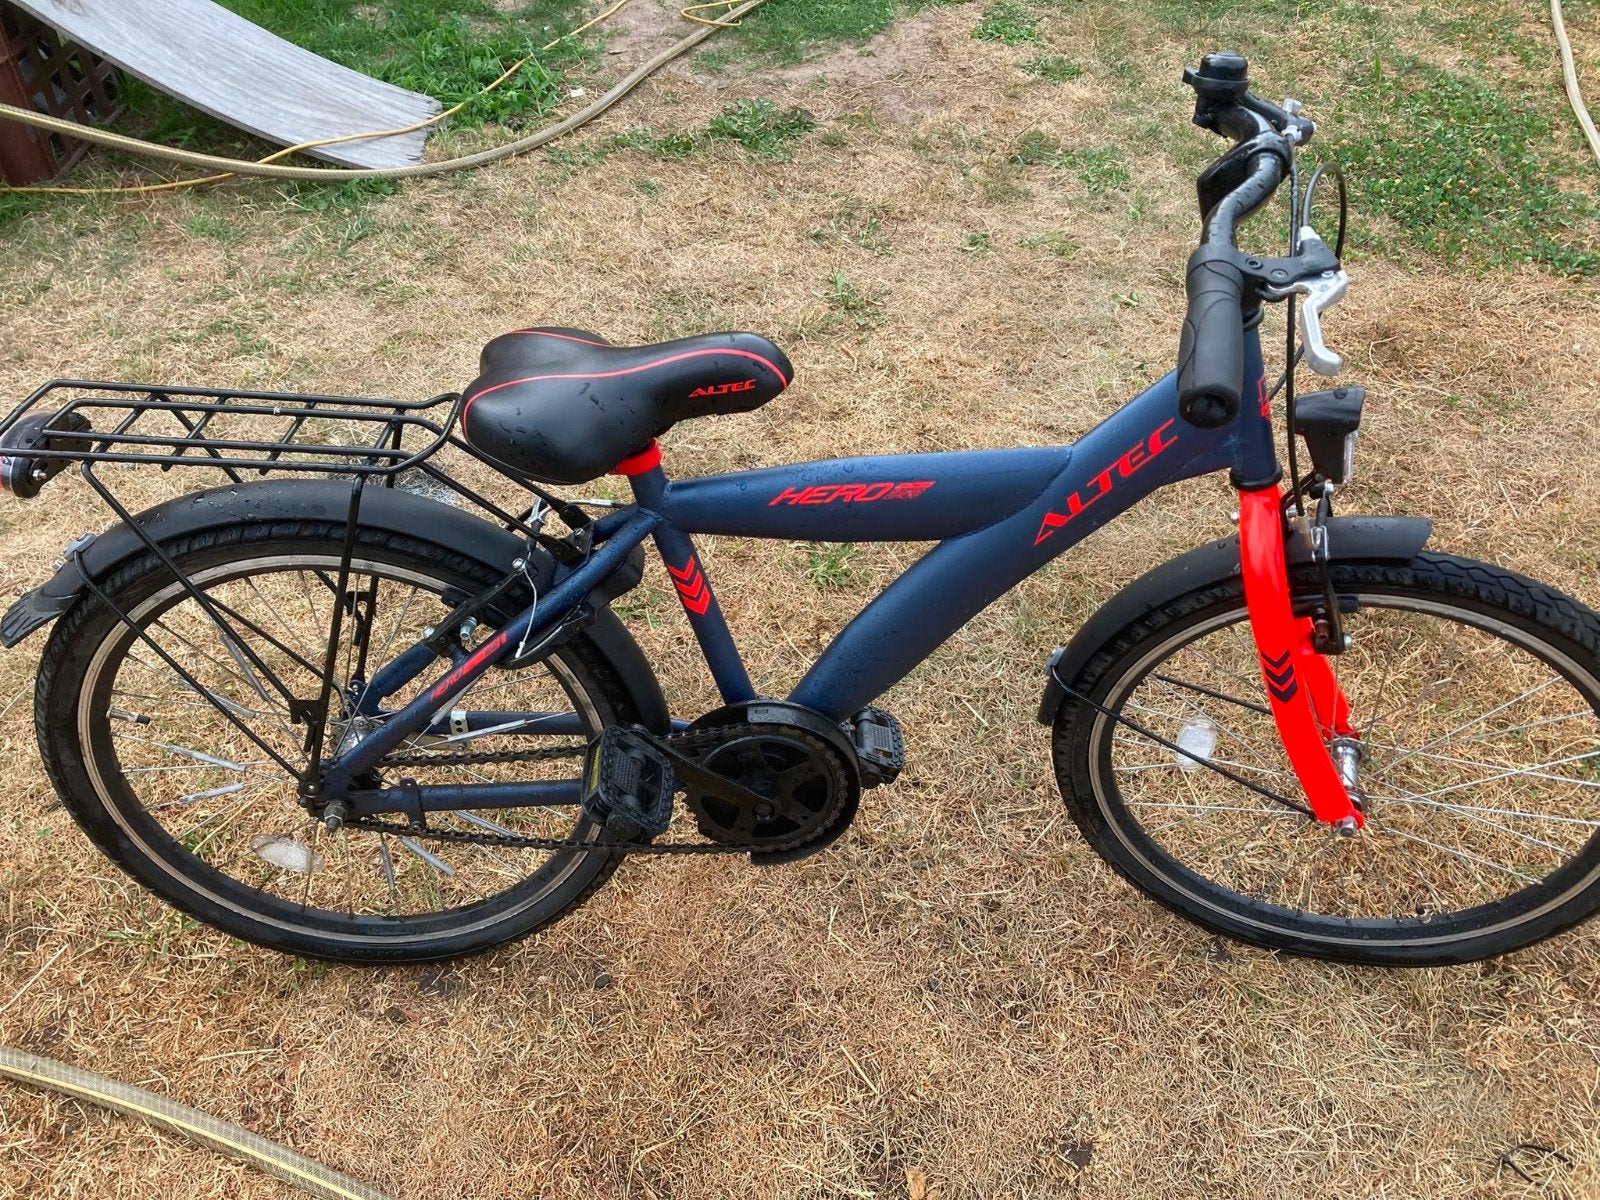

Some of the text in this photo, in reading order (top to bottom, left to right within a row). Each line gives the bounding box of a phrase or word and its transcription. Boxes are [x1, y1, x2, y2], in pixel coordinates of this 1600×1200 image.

[688, 378, 756, 398] ALTEC
[768, 481, 895, 506] HERO
[1033, 418, 1178, 547] ALTEC
